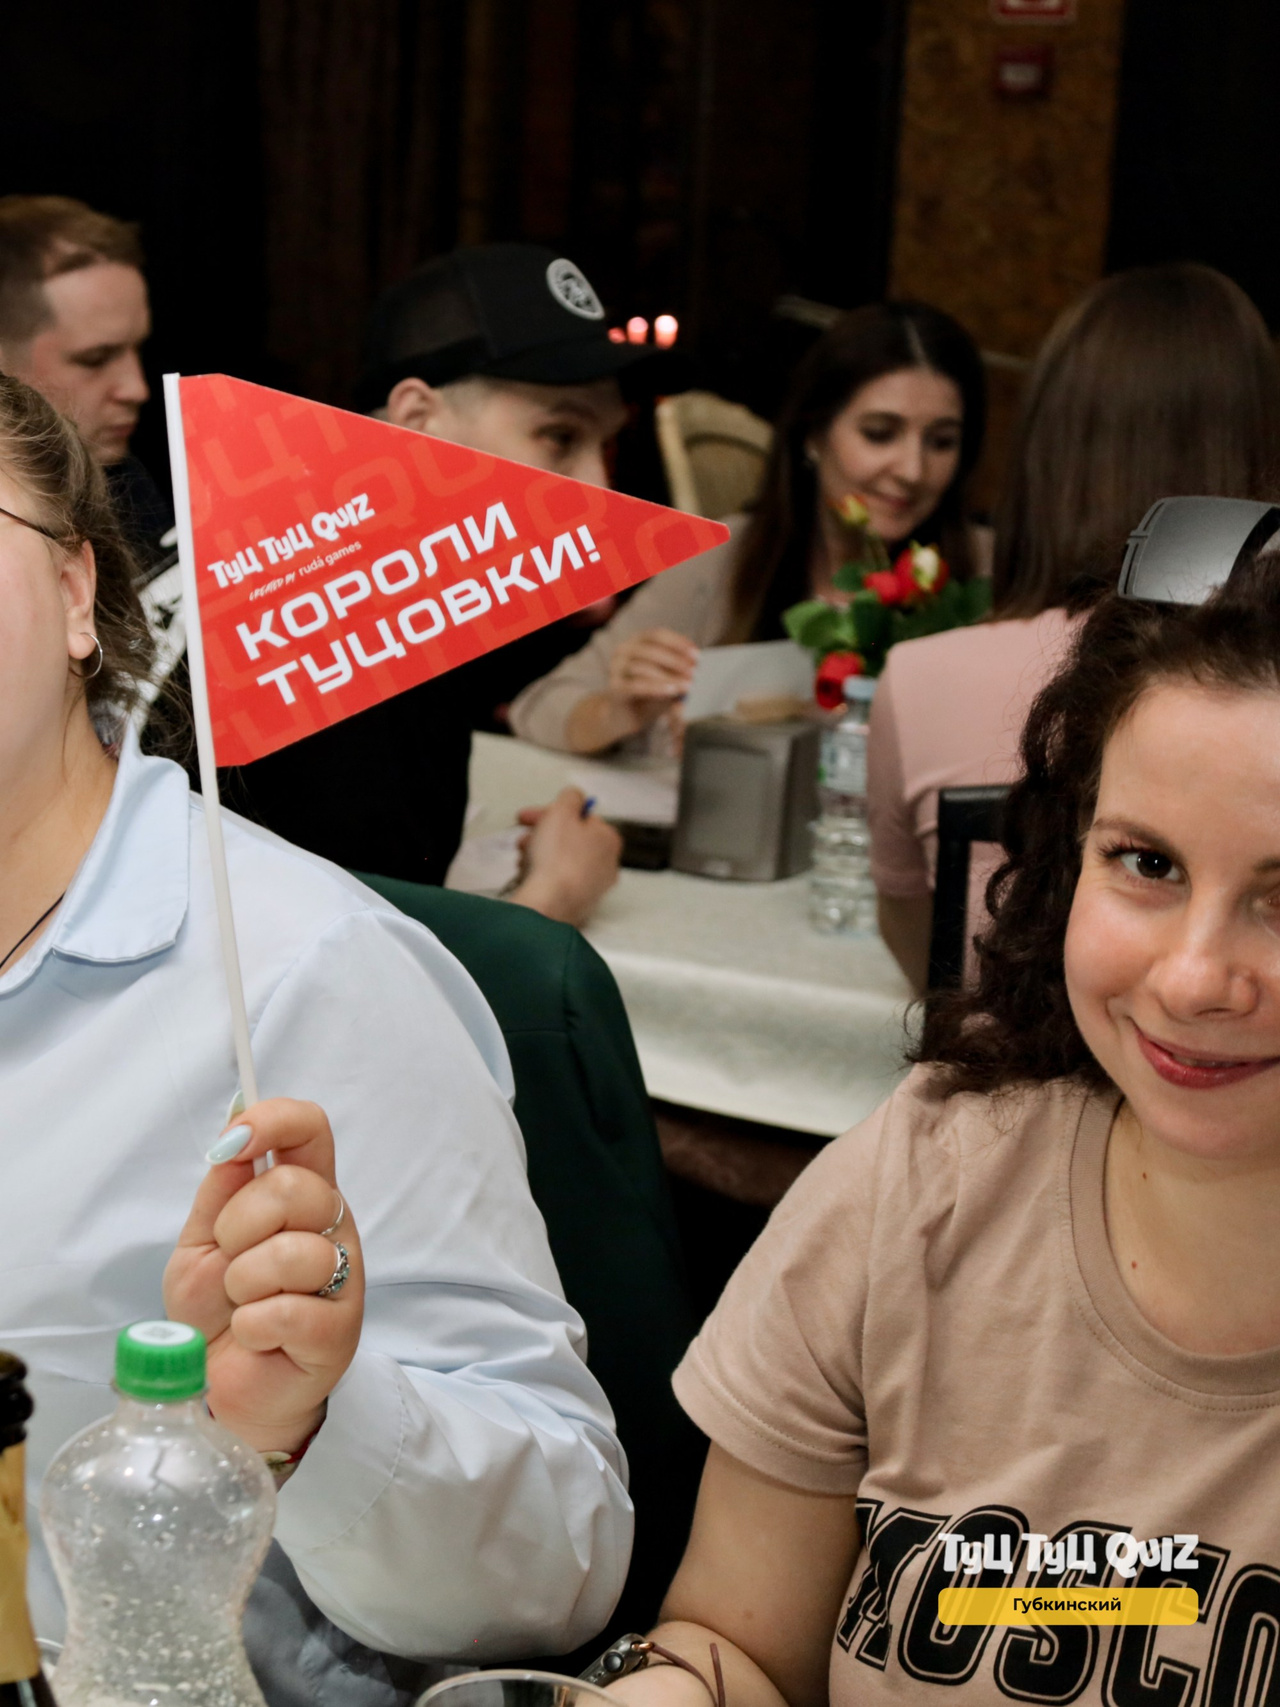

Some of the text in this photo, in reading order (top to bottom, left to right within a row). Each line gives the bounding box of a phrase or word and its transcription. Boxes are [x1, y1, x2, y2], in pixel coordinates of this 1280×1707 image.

[236, 501, 518, 661] КОРОЛИ
[256, 524, 602, 705] ТУЦОВКИ!
[325, 541, 362, 566] games
